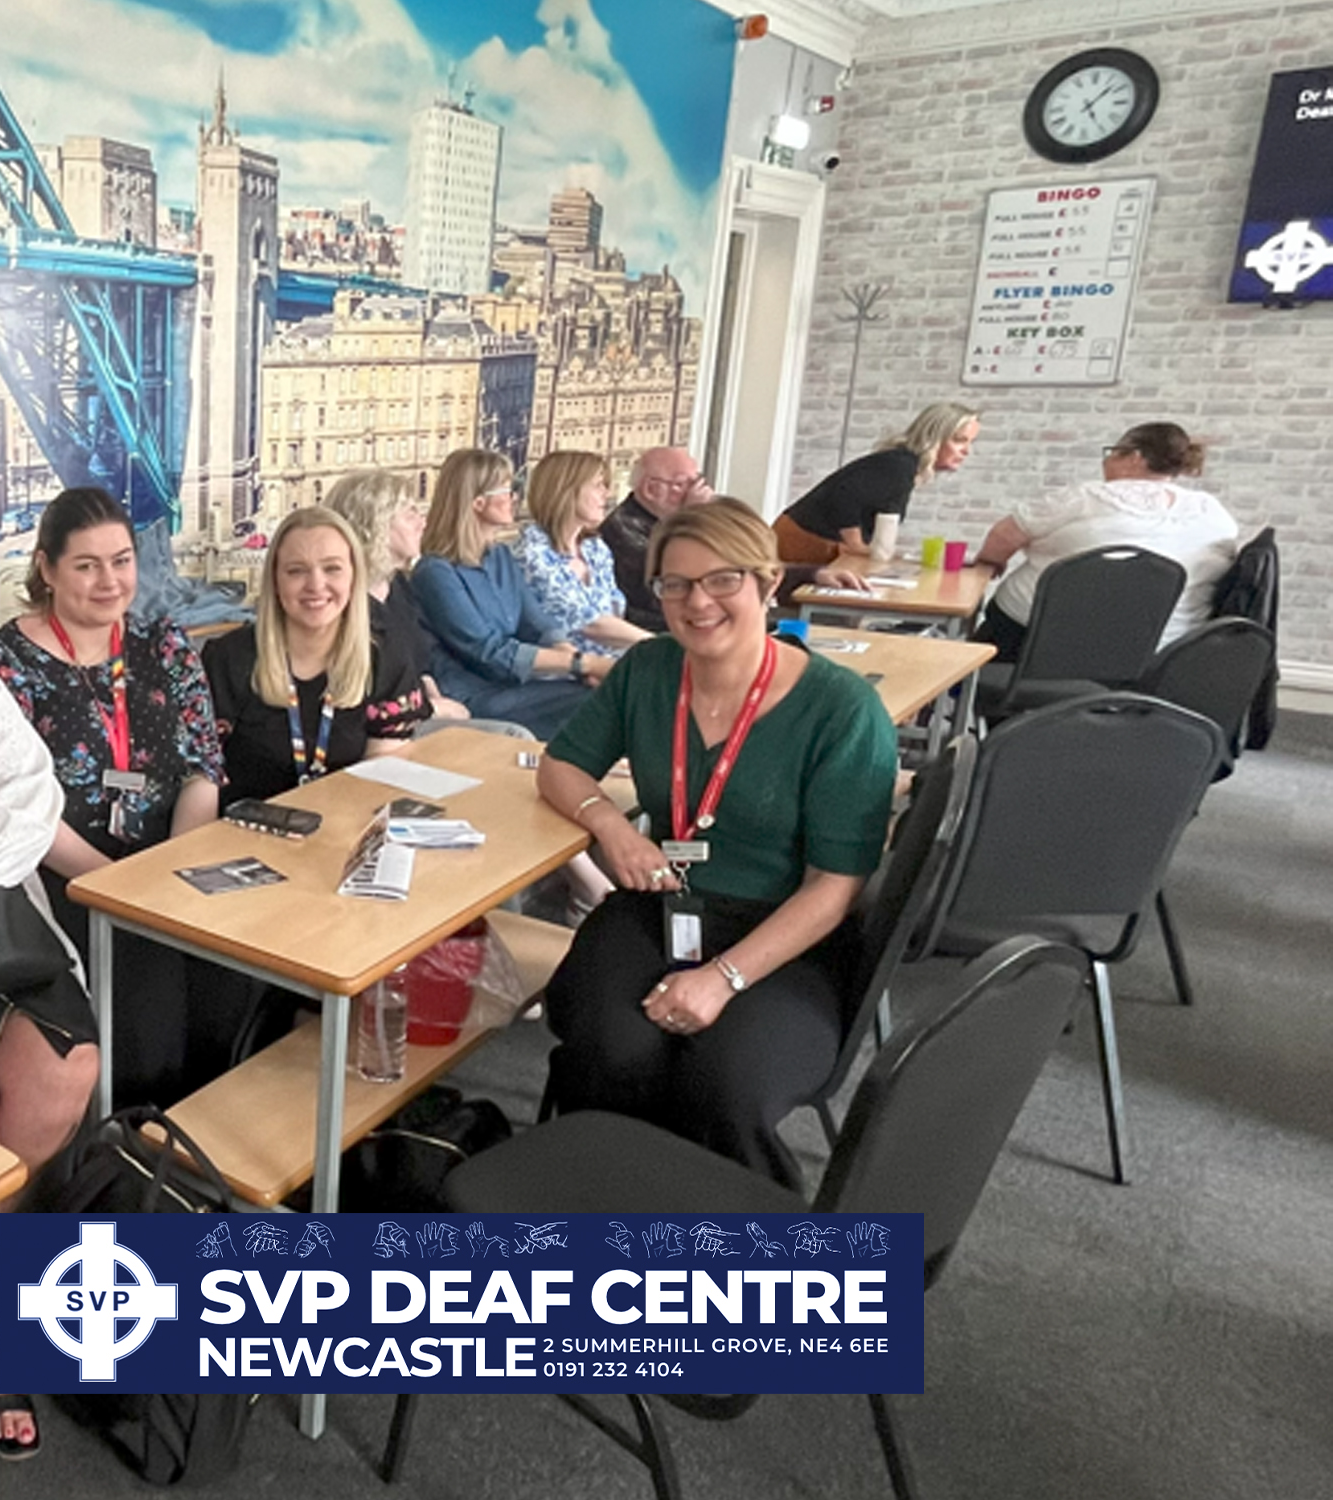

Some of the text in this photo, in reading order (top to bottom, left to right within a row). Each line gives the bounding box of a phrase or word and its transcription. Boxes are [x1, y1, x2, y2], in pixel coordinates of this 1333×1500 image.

[1298, 89, 1322, 104] Dr
[1037, 186, 1102, 203] BINGO
[994, 213, 1017, 222] FULL
[1021, 211, 1054, 221] HOUSE
[991, 232, 1014, 242] FULL
[1018, 230, 1052, 240] HOUSE
[988, 252, 1011, 261] FULL
[1015, 250, 1048, 259] HOUSE
[993, 283, 1114, 299] FLYER BINGO
[1007, 326, 1086, 339] KEY BOX
